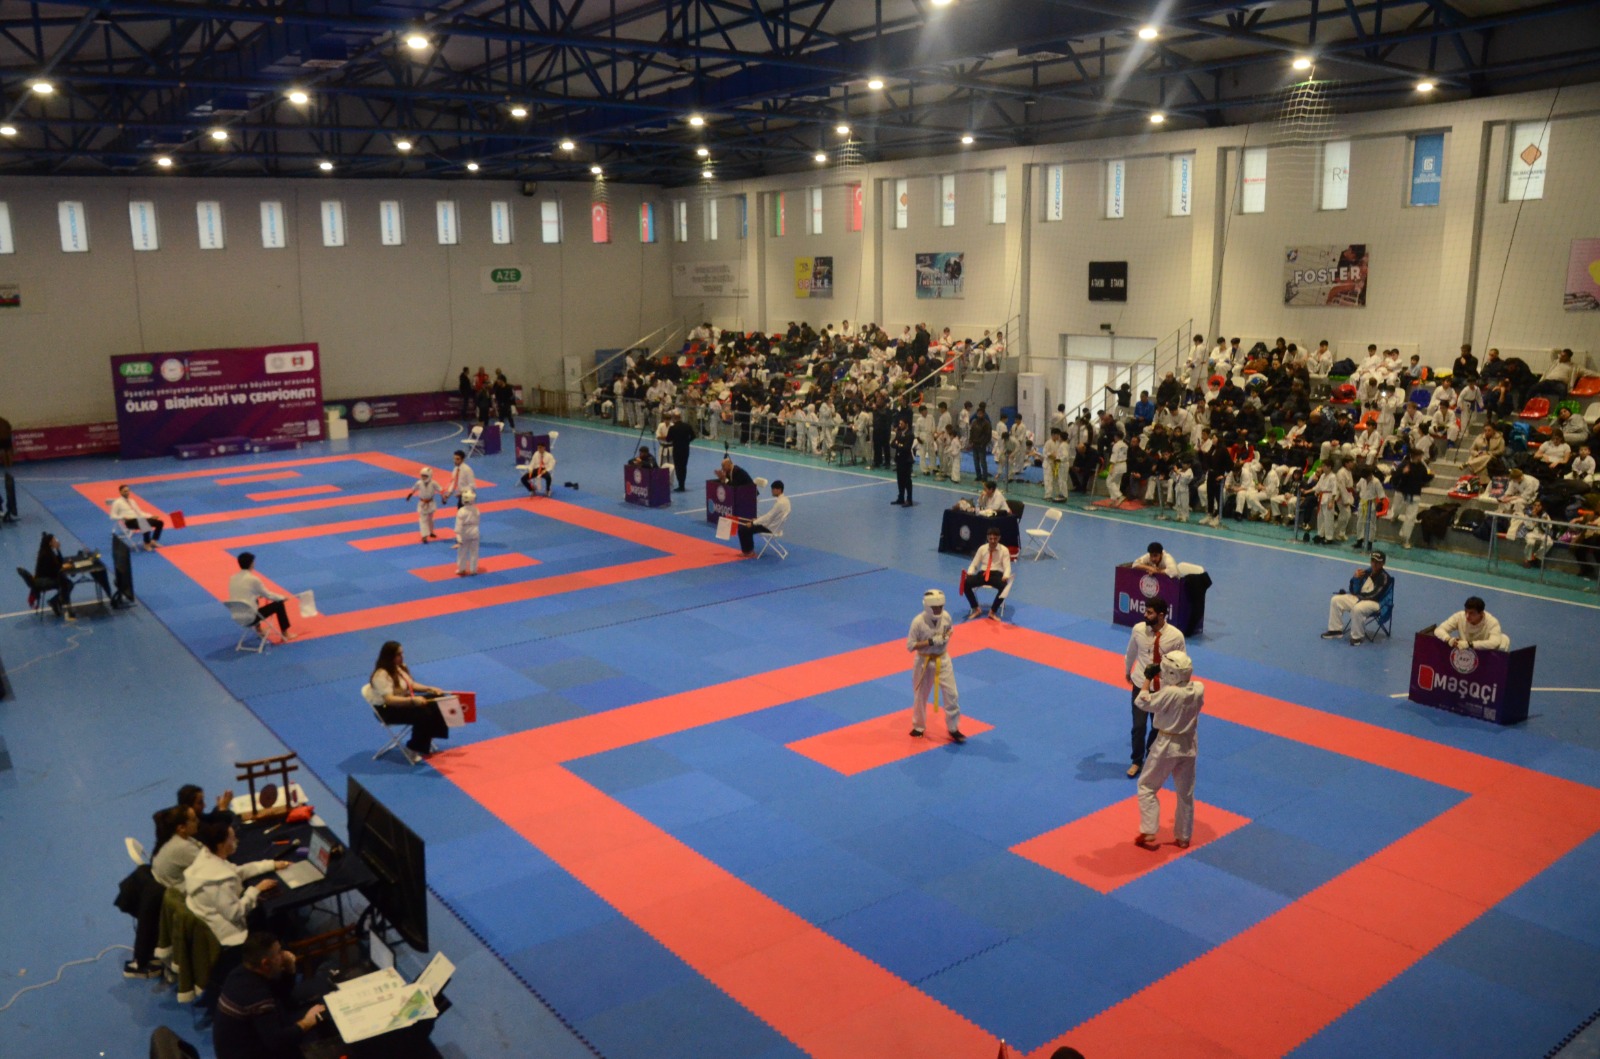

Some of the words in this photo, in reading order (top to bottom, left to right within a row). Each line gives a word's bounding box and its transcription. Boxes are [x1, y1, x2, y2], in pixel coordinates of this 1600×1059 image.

[1181, 157, 1189, 212] AZEROBOT
[496, 271, 517, 281] AZE
[1294, 265, 1361, 285] FOSTER
[125, 362, 148, 375] AZE
[125, 398, 158, 413] ÖLKƏ
[165, 392, 228, 410] BİRİNCİLİYİ
[231, 393, 247, 405] VƏ
[249, 387, 316, 405] ÇEMPİONATI
